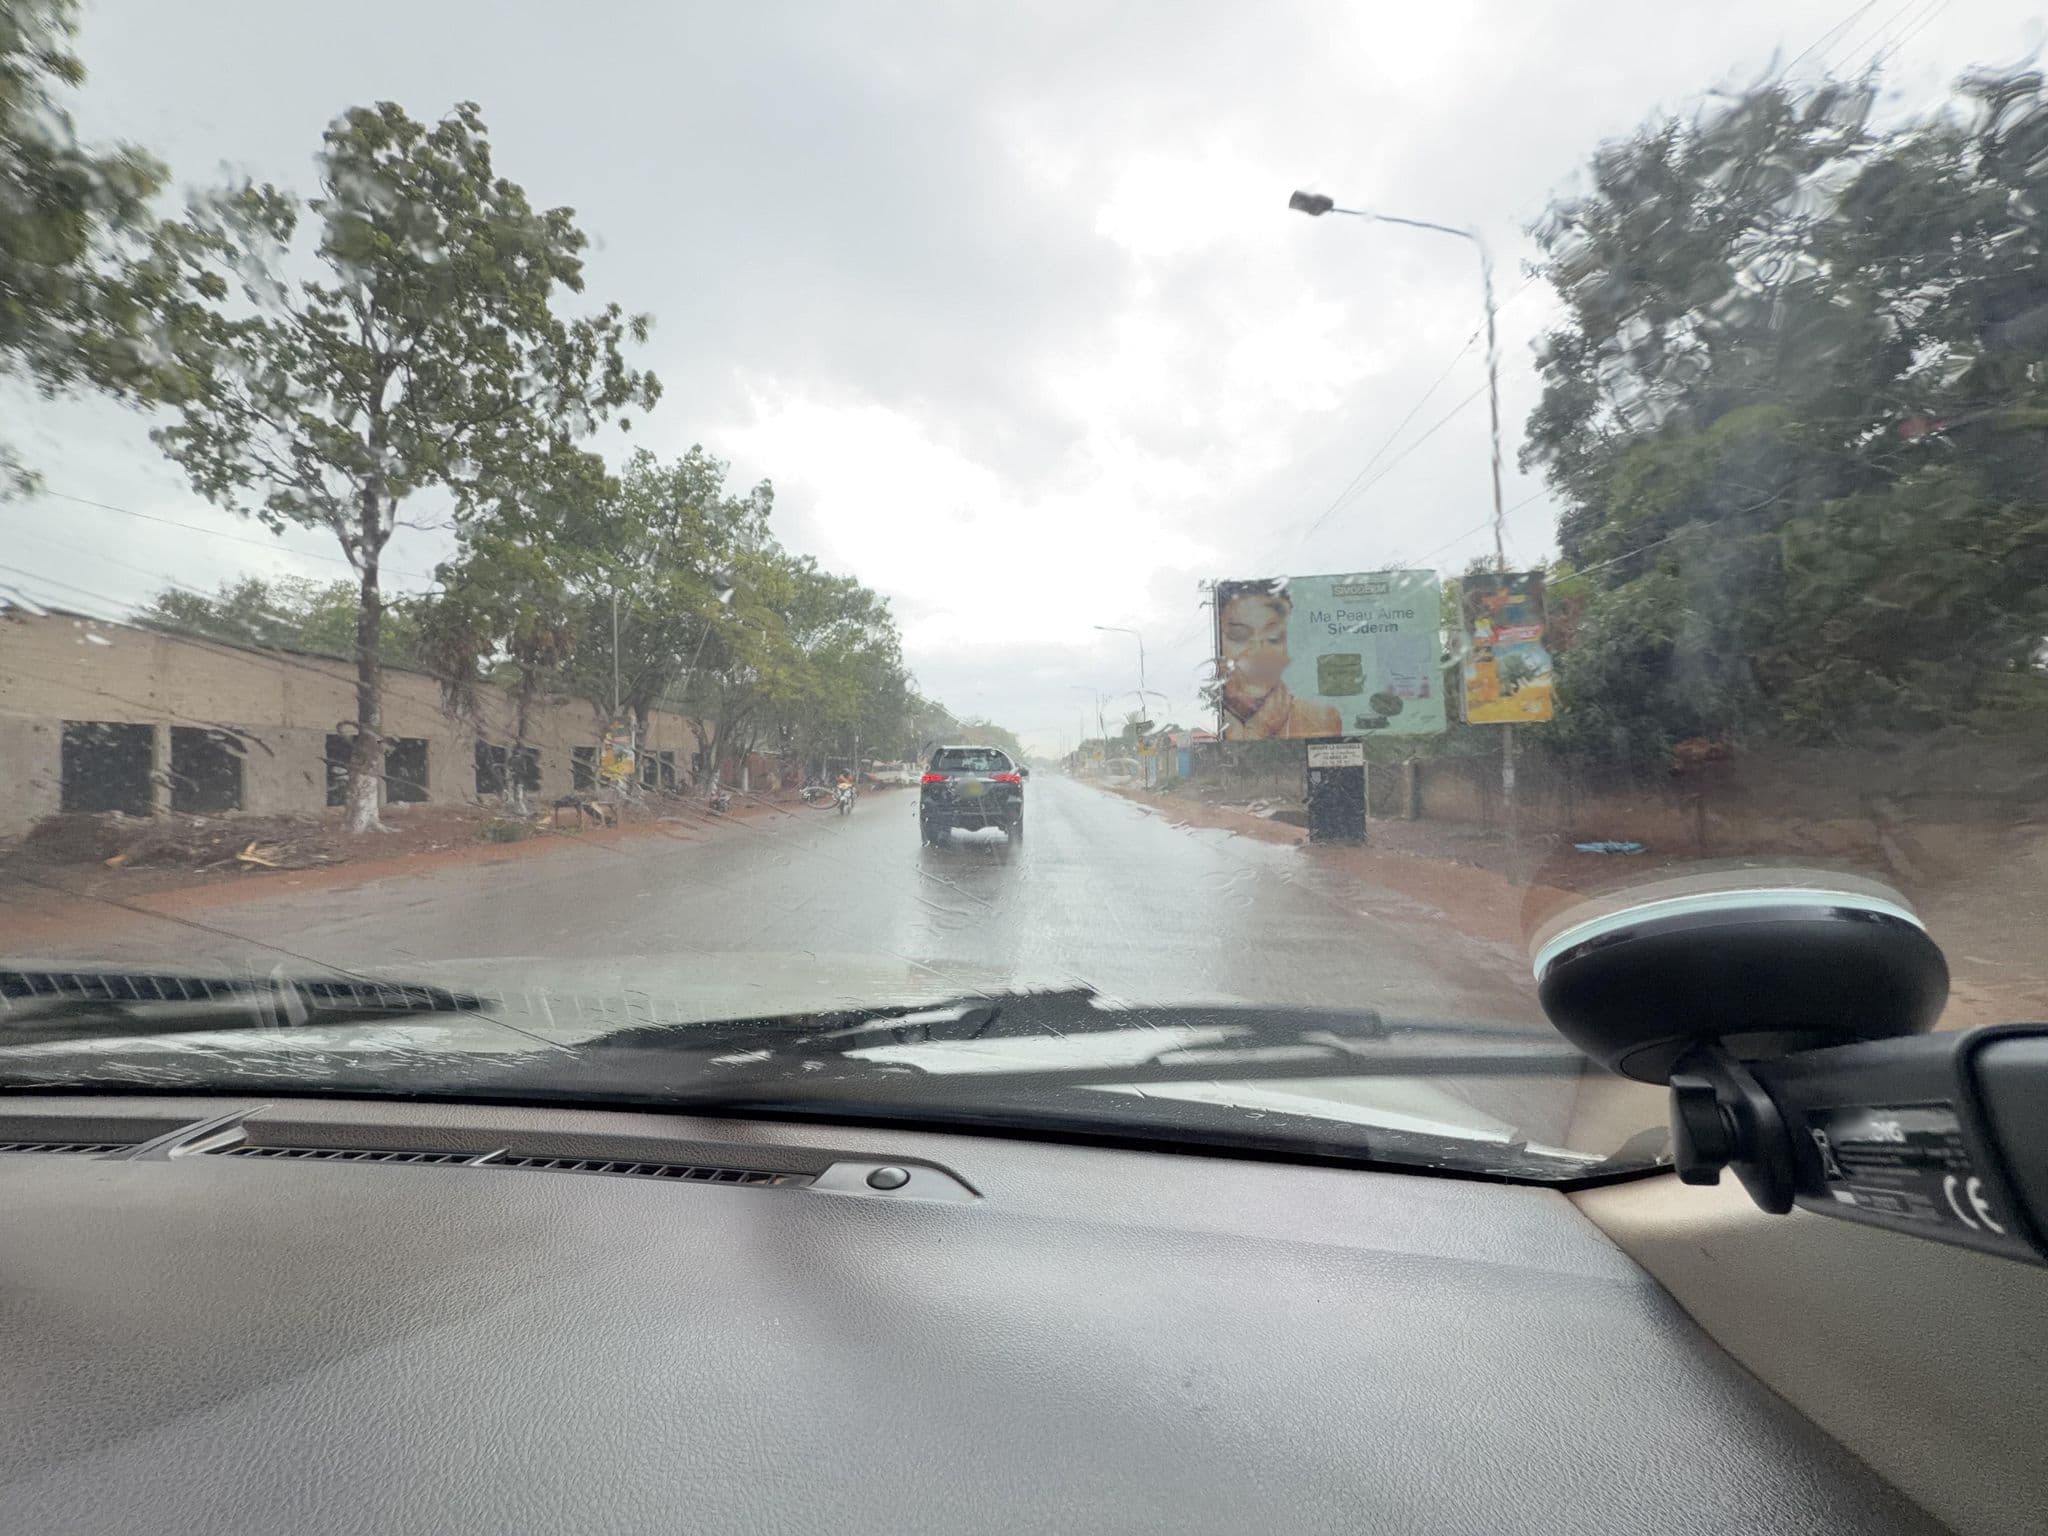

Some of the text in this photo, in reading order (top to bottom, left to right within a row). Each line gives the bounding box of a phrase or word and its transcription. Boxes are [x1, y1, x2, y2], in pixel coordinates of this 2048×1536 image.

[1310, 608, 1415, 623] Ma Peau Aime
